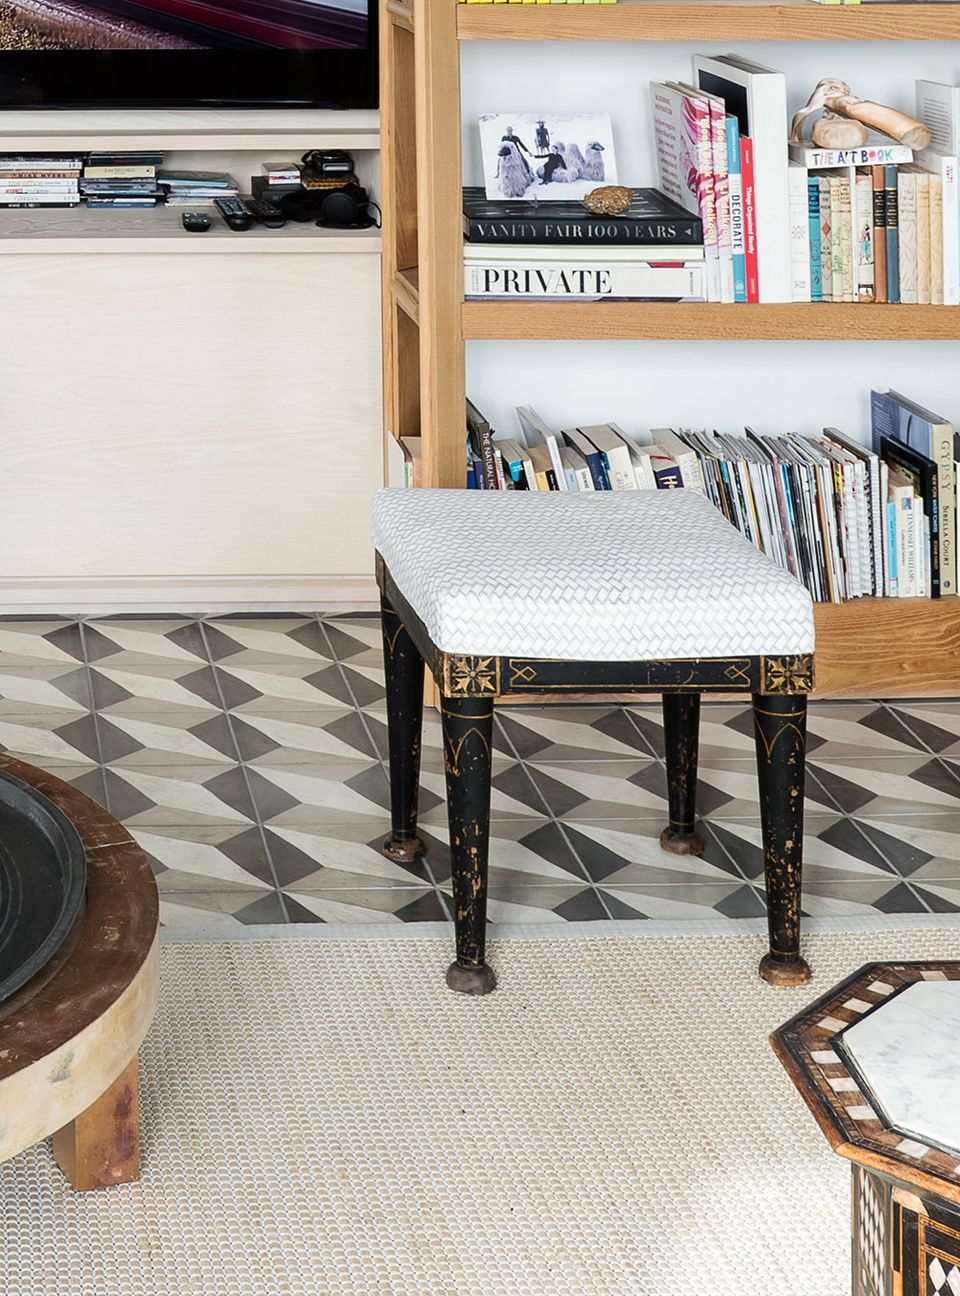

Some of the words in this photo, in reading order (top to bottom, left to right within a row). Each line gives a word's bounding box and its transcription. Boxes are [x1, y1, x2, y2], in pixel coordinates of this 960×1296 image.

[744, 186, 753, 205] Things
[476, 224, 538, 238] VANITY
[545, 224, 583, 238] FAIR
[588, 224, 618, 238] 100
[624, 224, 677, 238] YEARS
[745, 206, 755, 234] Organized
[747, 235, 755, 254] Neatly
[482, 268, 613, 294] PRIVATE
[941, 440, 951, 492] GYPSY
[942, 505, 951, 537] SIBELLA
[943, 539, 951, 567] COURT
